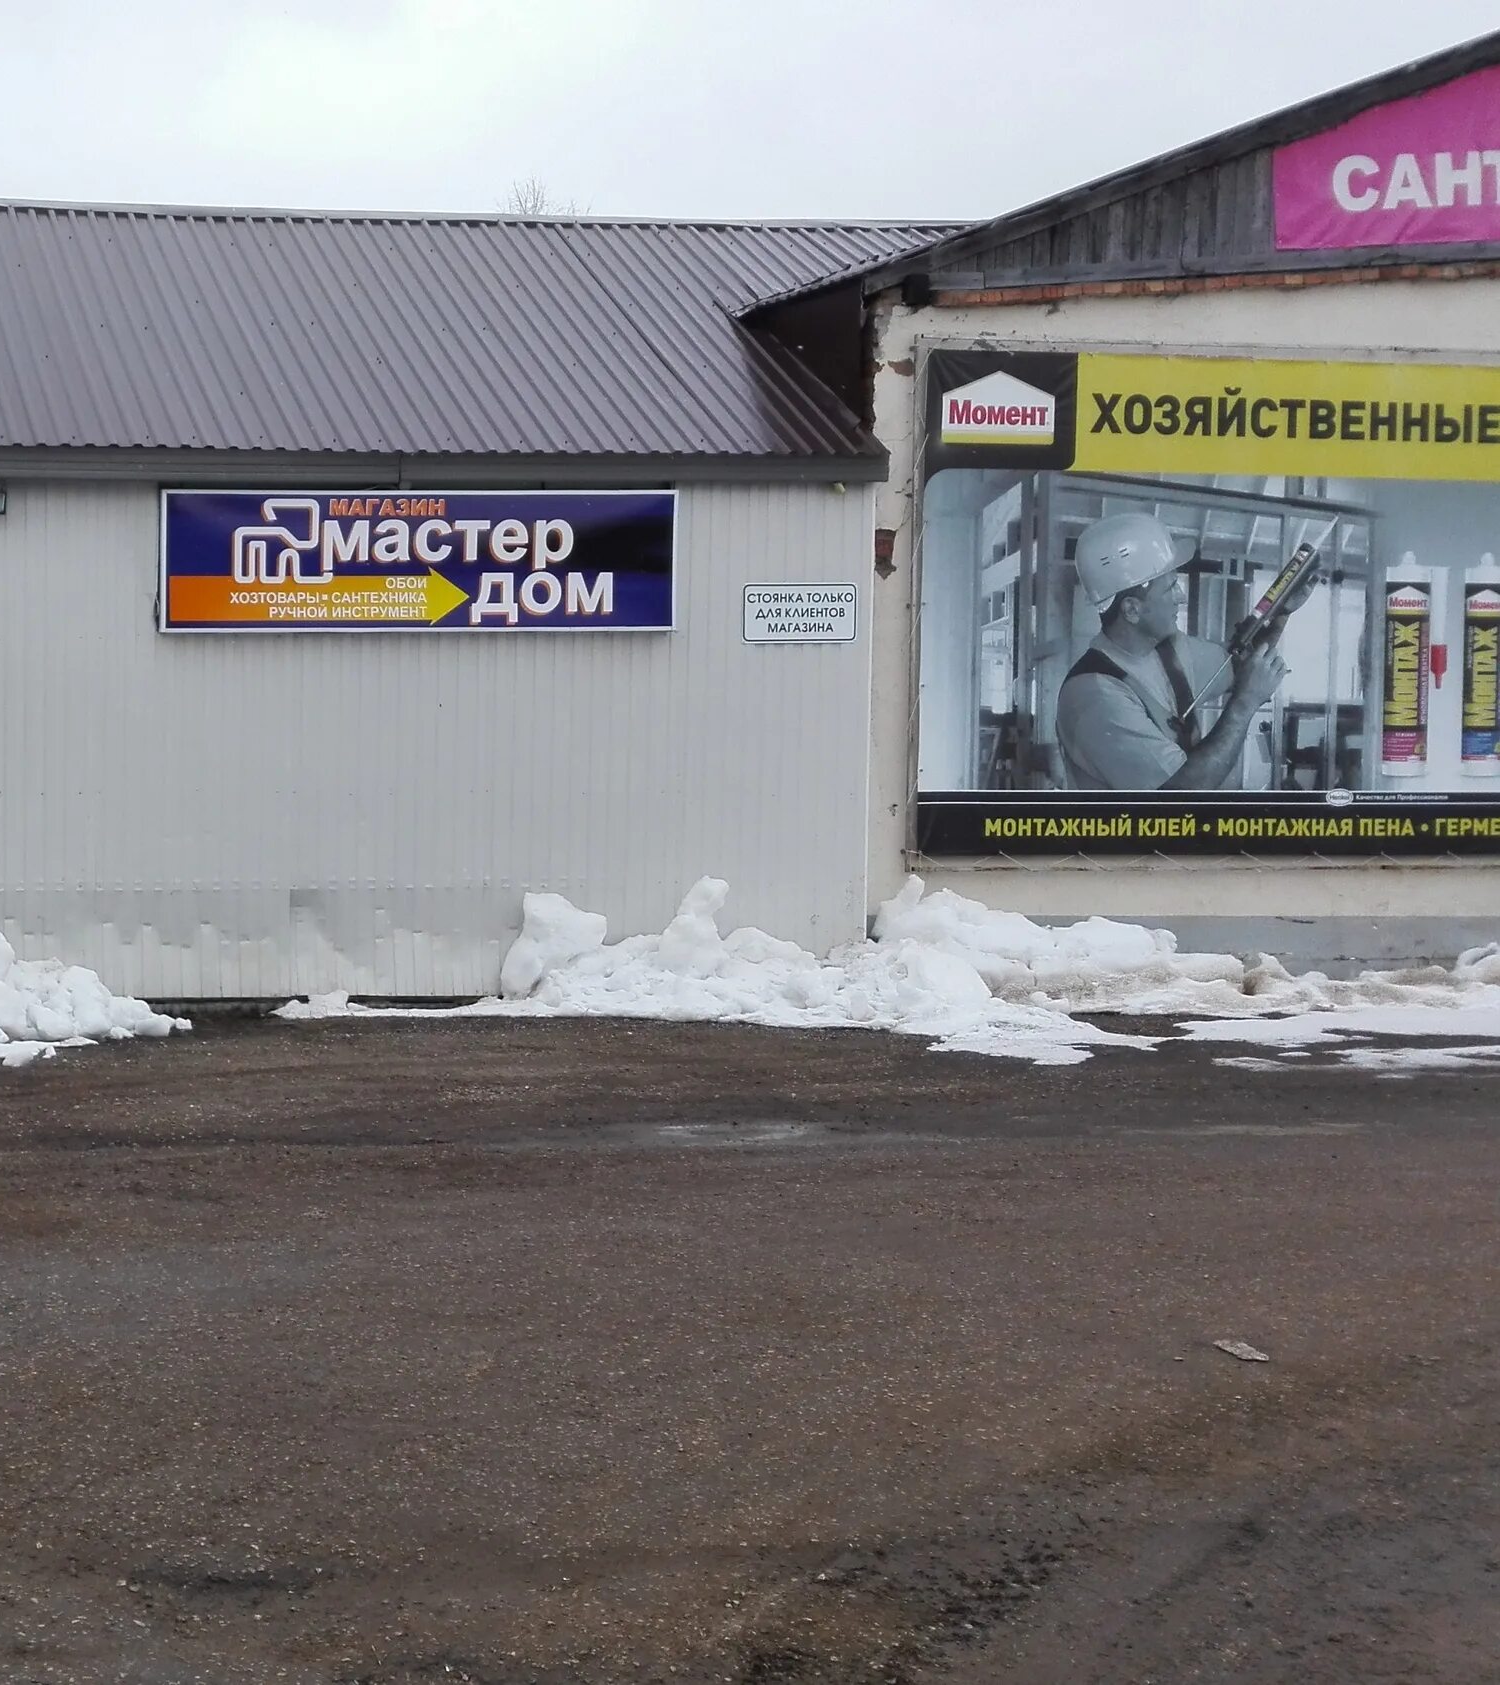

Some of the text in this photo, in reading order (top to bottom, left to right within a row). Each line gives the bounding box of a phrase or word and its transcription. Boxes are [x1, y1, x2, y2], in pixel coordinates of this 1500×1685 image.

[949, 400, 1048, 426] Момент
[1091, 387, 1500, 443] ХОЗЯЙСТВЕННЫЕ
[329, 498, 445, 516] МАГАЗИН
[322, 517, 575, 569] мастер
[386, 577, 427, 589] ОБОИ
[230, 592, 427, 604] ХОЗТОВАРЫ САНТЕХНИКА
[470, 570, 615, 625] дом
[747, 592, 853, 604] СТОЯНКА ТОЛЬКО
[269, 604, 427, 618] РУЧНОЙ ИНСТРУМЕНТ
[756, 607, 845, 619] ДЛЯ КЛИЕНТОВ
[768, 622, 833, 633] МАГАЗИНА
[984, 814, 1500, 837] МОНТАЖНЫЙ КЛЕЙ МОНТАЖНАЯ ПЕНА ГЕРМЕ
